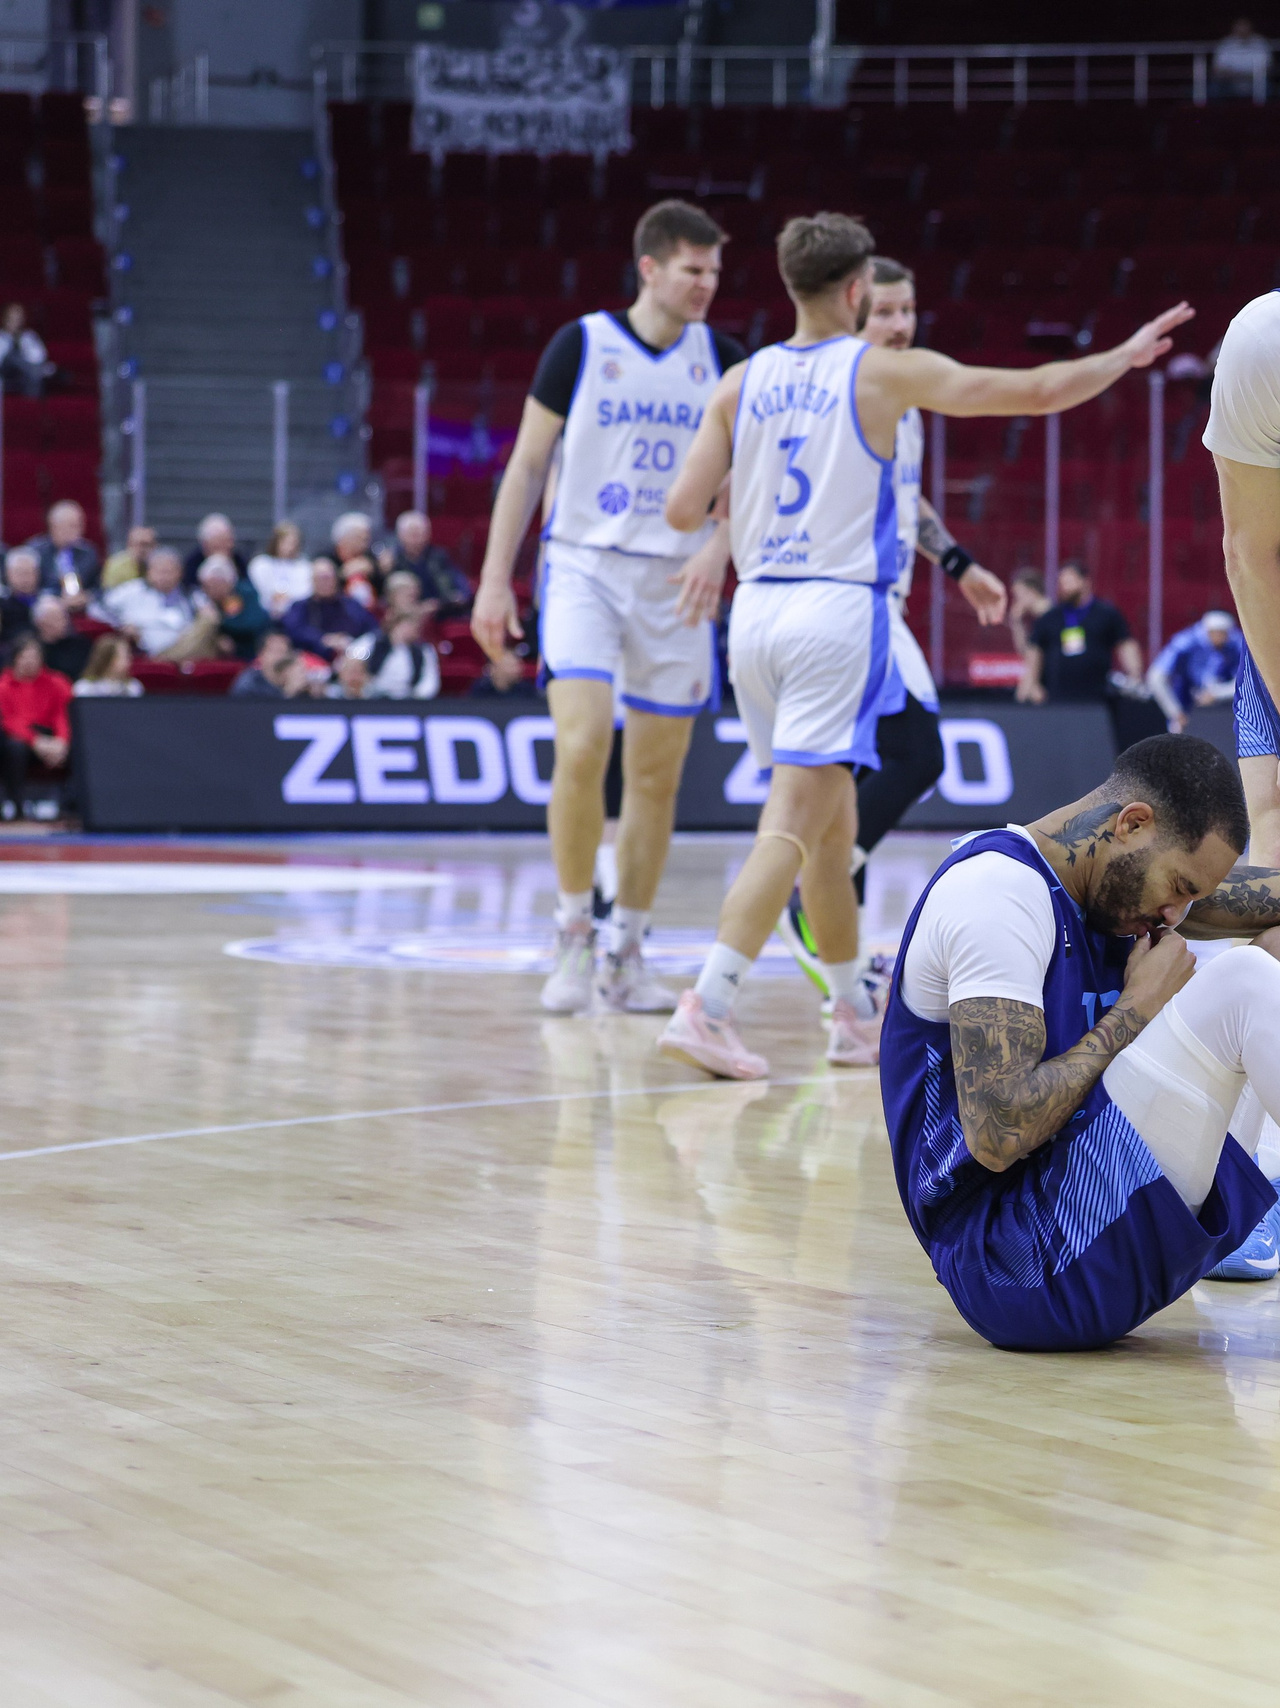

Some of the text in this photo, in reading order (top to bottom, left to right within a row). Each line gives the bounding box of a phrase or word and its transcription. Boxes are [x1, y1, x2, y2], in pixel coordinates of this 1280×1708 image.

[632, 437, 675, 473] 20
[775, 435, 812, 517] 3
[713, 716, 1015, 806] ZO
[1081, 989, 1121, 1032] 1
